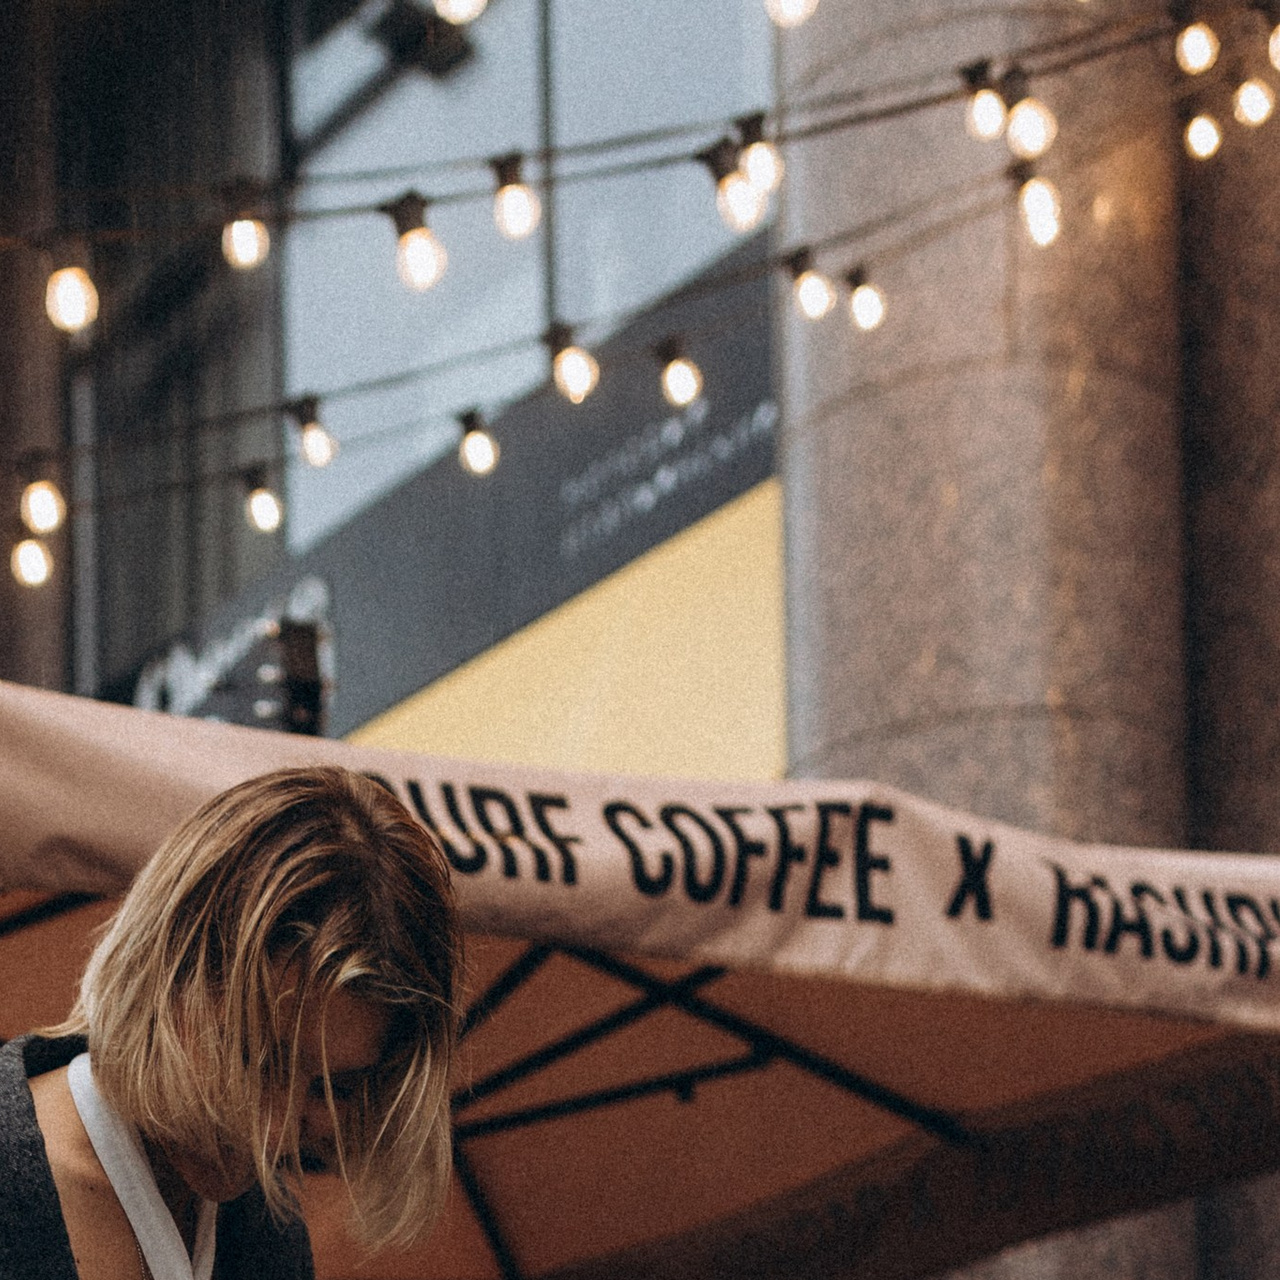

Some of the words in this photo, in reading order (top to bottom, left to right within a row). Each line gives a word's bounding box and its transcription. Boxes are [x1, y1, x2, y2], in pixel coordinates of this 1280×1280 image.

[363, 771, 582, 886] URF
[602, 800, 895, 925] COFFEE
[945, 833, 994, 921] X
